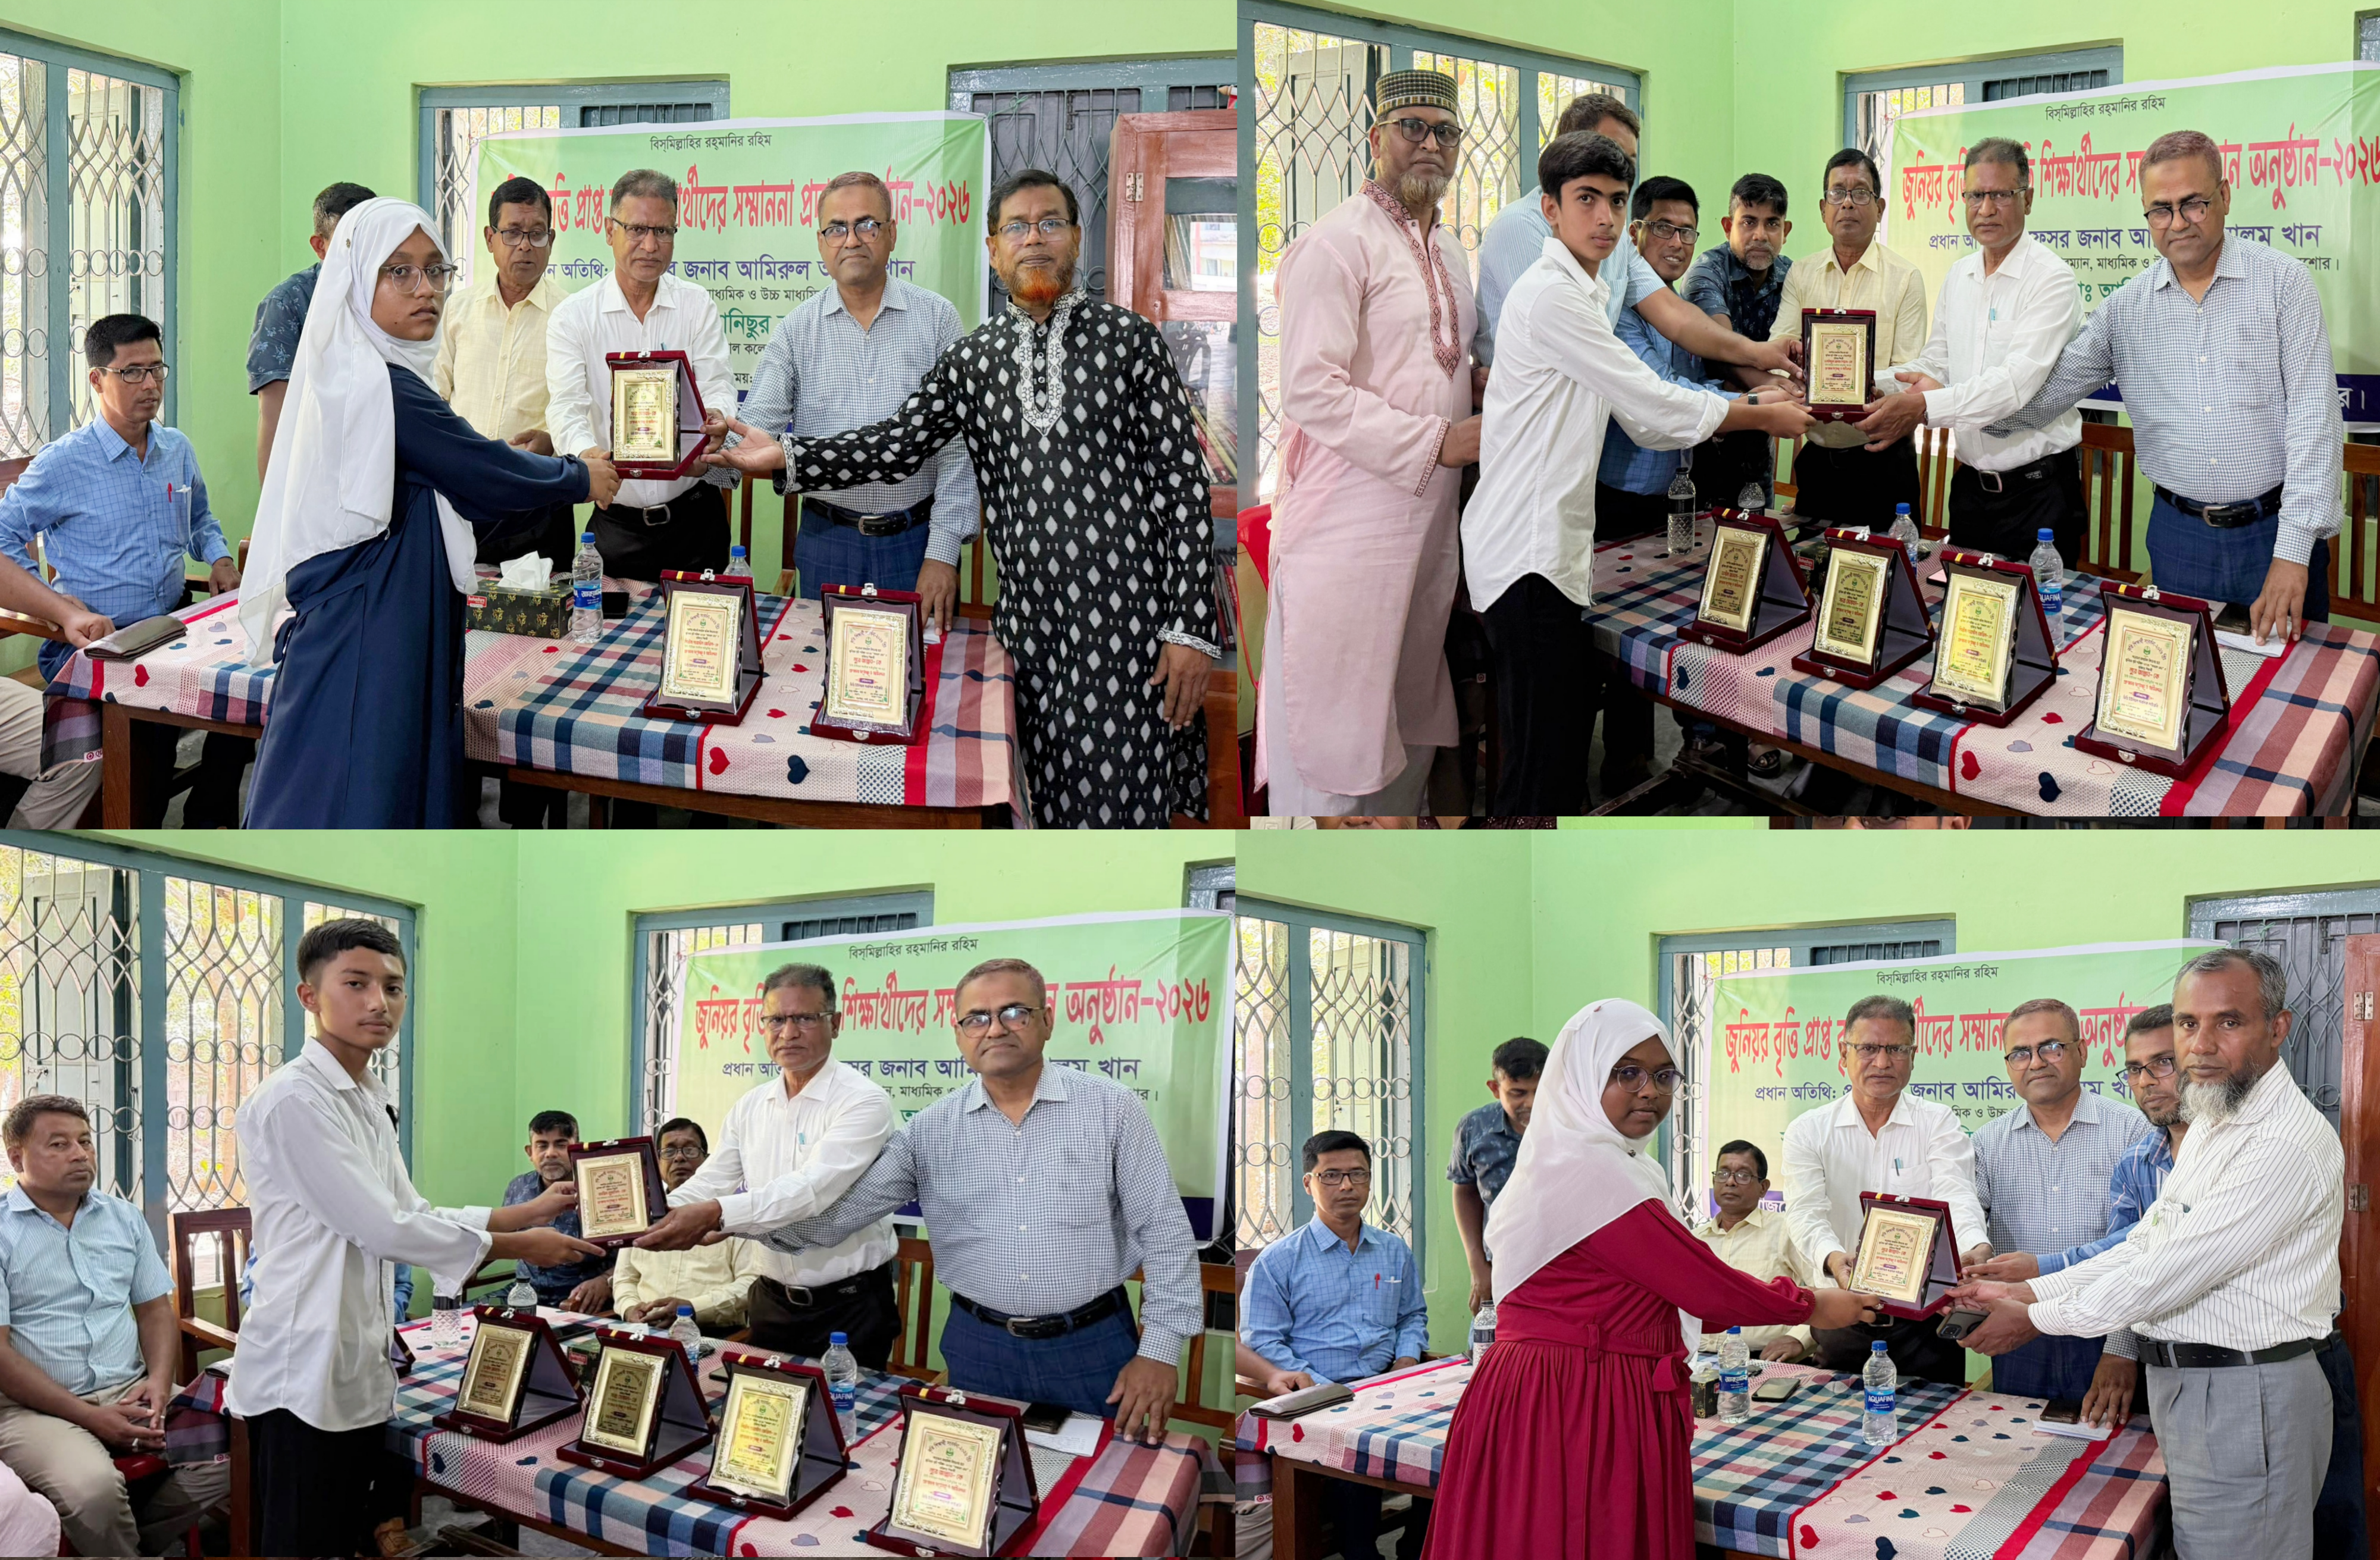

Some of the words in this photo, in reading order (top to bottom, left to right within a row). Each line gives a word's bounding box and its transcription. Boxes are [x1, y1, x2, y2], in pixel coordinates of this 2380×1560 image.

[2140, 94, 2166, 110] রহিম
[747, 131, 772, 148] রহিম
[1903, 149, 1944, 221] জুনিয়র
[2040, 130, 2121, 202] শিক্ষার্থীদের
[575, 184, 605, 234] প্রাপ্ত
[734, 178, 795, 228] সম্মাননা
[1928, 233, 1959, 250] প্রধান
[2075, 227, 2124, 249] জনাব
[2281, 223, 2323, 249] খান
[683, 258, 731, 281] জনাব
[737, 253, 811, 281] আমিরুল
[2097, 254, 2138, 270] মাধ্যমিক
[2141, 258, 2150, 268] ও
[749, 290, 756, 300] ও
[761, 286, 780, 300] উচ্চ
[734, 373, 753, 386] ময়:
[2038, 593, 2060, 603] QUAFINA
[951, 937, 979, 953] রহিম
[1974, 964, 1999, 979] রহিম
[696, 984, 739, 1050] জুনিয়র
[841, 969, 929, 1035] শিক্ষার্থীদের
[1065, 963, 1211, 1045] অনুষ্ঠান-২০২৬
[1725, 1008, 1770, 1074] জুনিয়র
[1773, 1005, 1800, 1079] বৃত্তি
[1803, 1015, 1833, 1061] প্রাপ্ত
[722, 1061, 754, 1077] প্রধান
[878, 1058, 929, 1079] জনাব
[1098, 1055, 1142, 1080] খান
[900, 1083, 944, 1098] মাধ্যমিক
[1755, 1086, 1787, 1101] প্রধান
[1791, 1082, 1836, 1101] অতিথি:
[1909, 1080, 1957, 1101] জনাব
[1975, 1109, 1983, 1119] ও
[829, 1392, 853, 1401] QUAFINA
[1868, 1395, 1894, 1404] AQUAFINA
